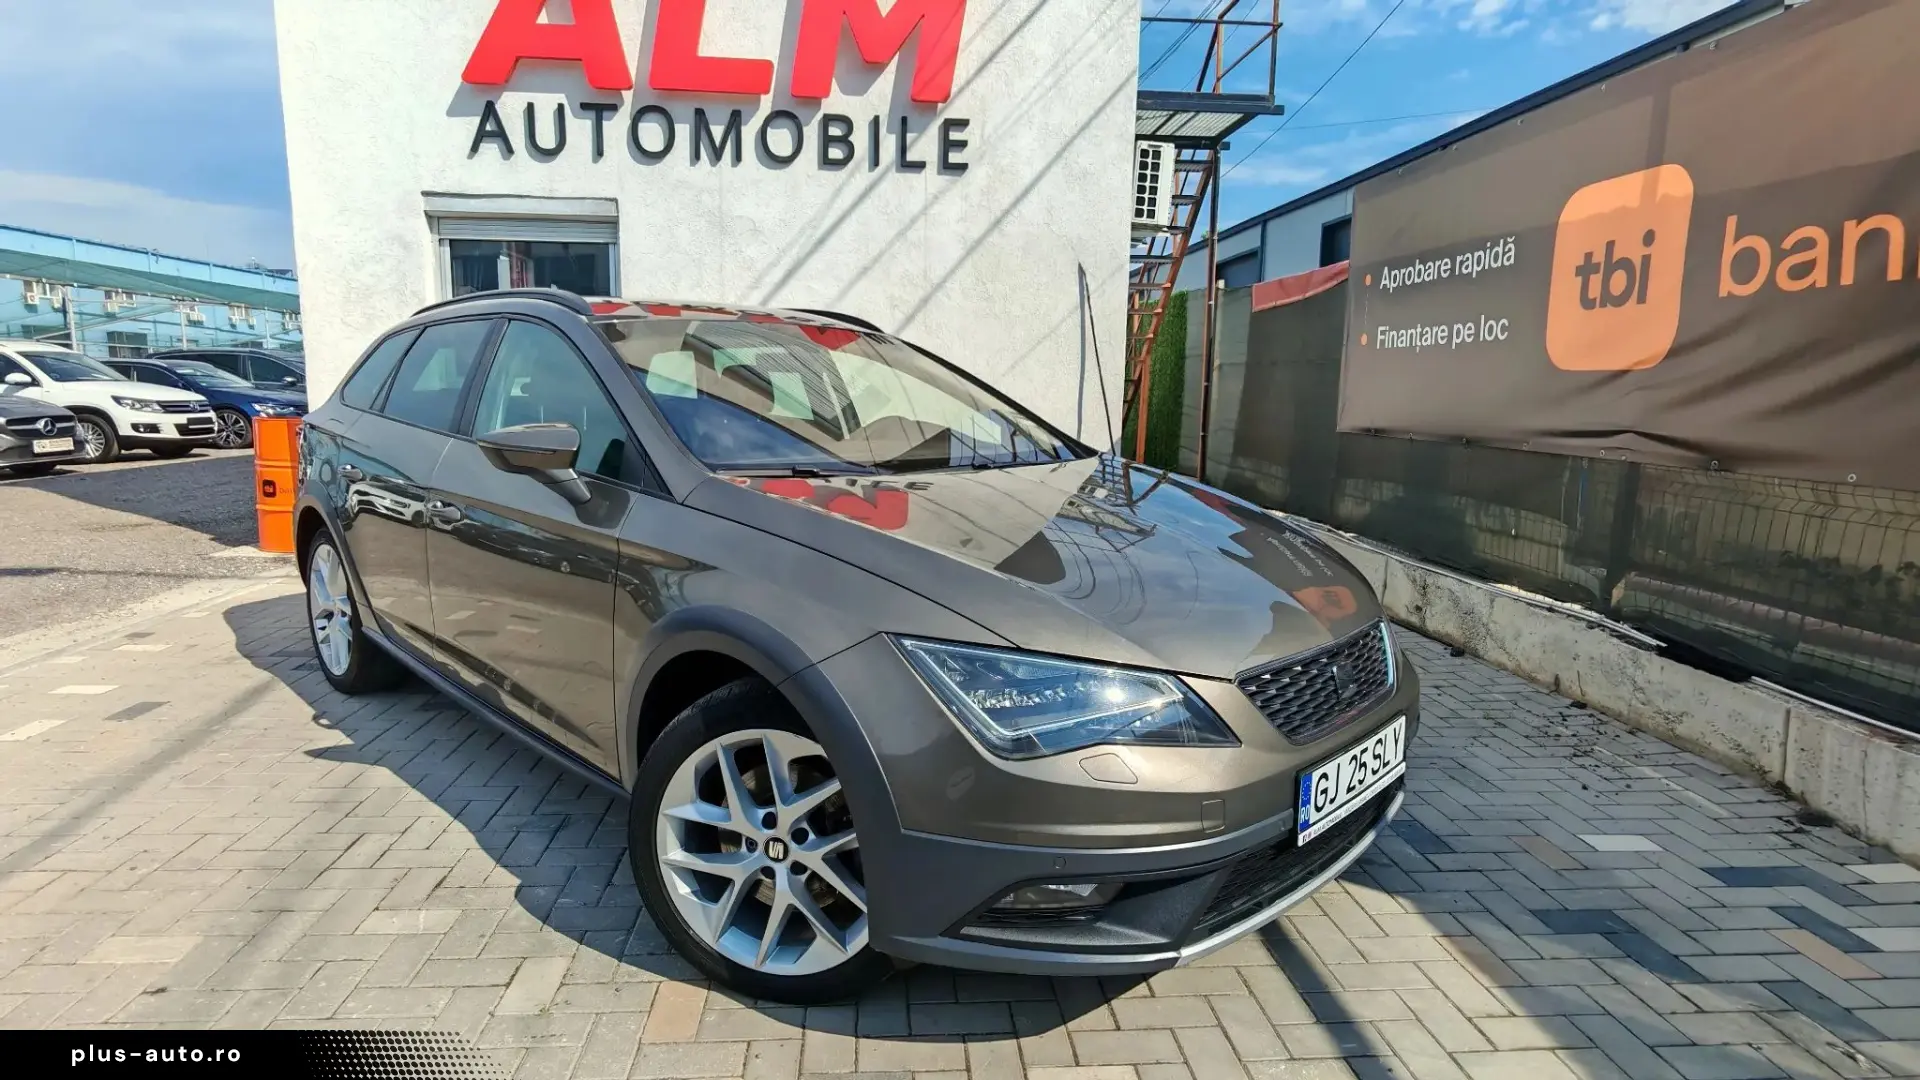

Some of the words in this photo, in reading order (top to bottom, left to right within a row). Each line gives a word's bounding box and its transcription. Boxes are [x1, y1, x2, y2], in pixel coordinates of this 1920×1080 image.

[461, 0, 967, 103] ALM
[470, 100, 970, 171] AUTOMOBILE
[1379, 257, 1452, 293] Aprobare
[1455, 236, 1516, 278] rapidă
[1574, 228, 1657, 310] tbi
[1718, 213, 1920, 298] ban
[1376, 323, 1449, 353] Finanțare
[1451, 321, 1475, 350] pe
[1479, 314, 1509, 342] loc
[1314, 764, 1341, 813] GJ
[1346, 747, 1369, 795] 25
[1371, 722, 1403, 776] SLY
[1300, 803, 1310, 823] RO
